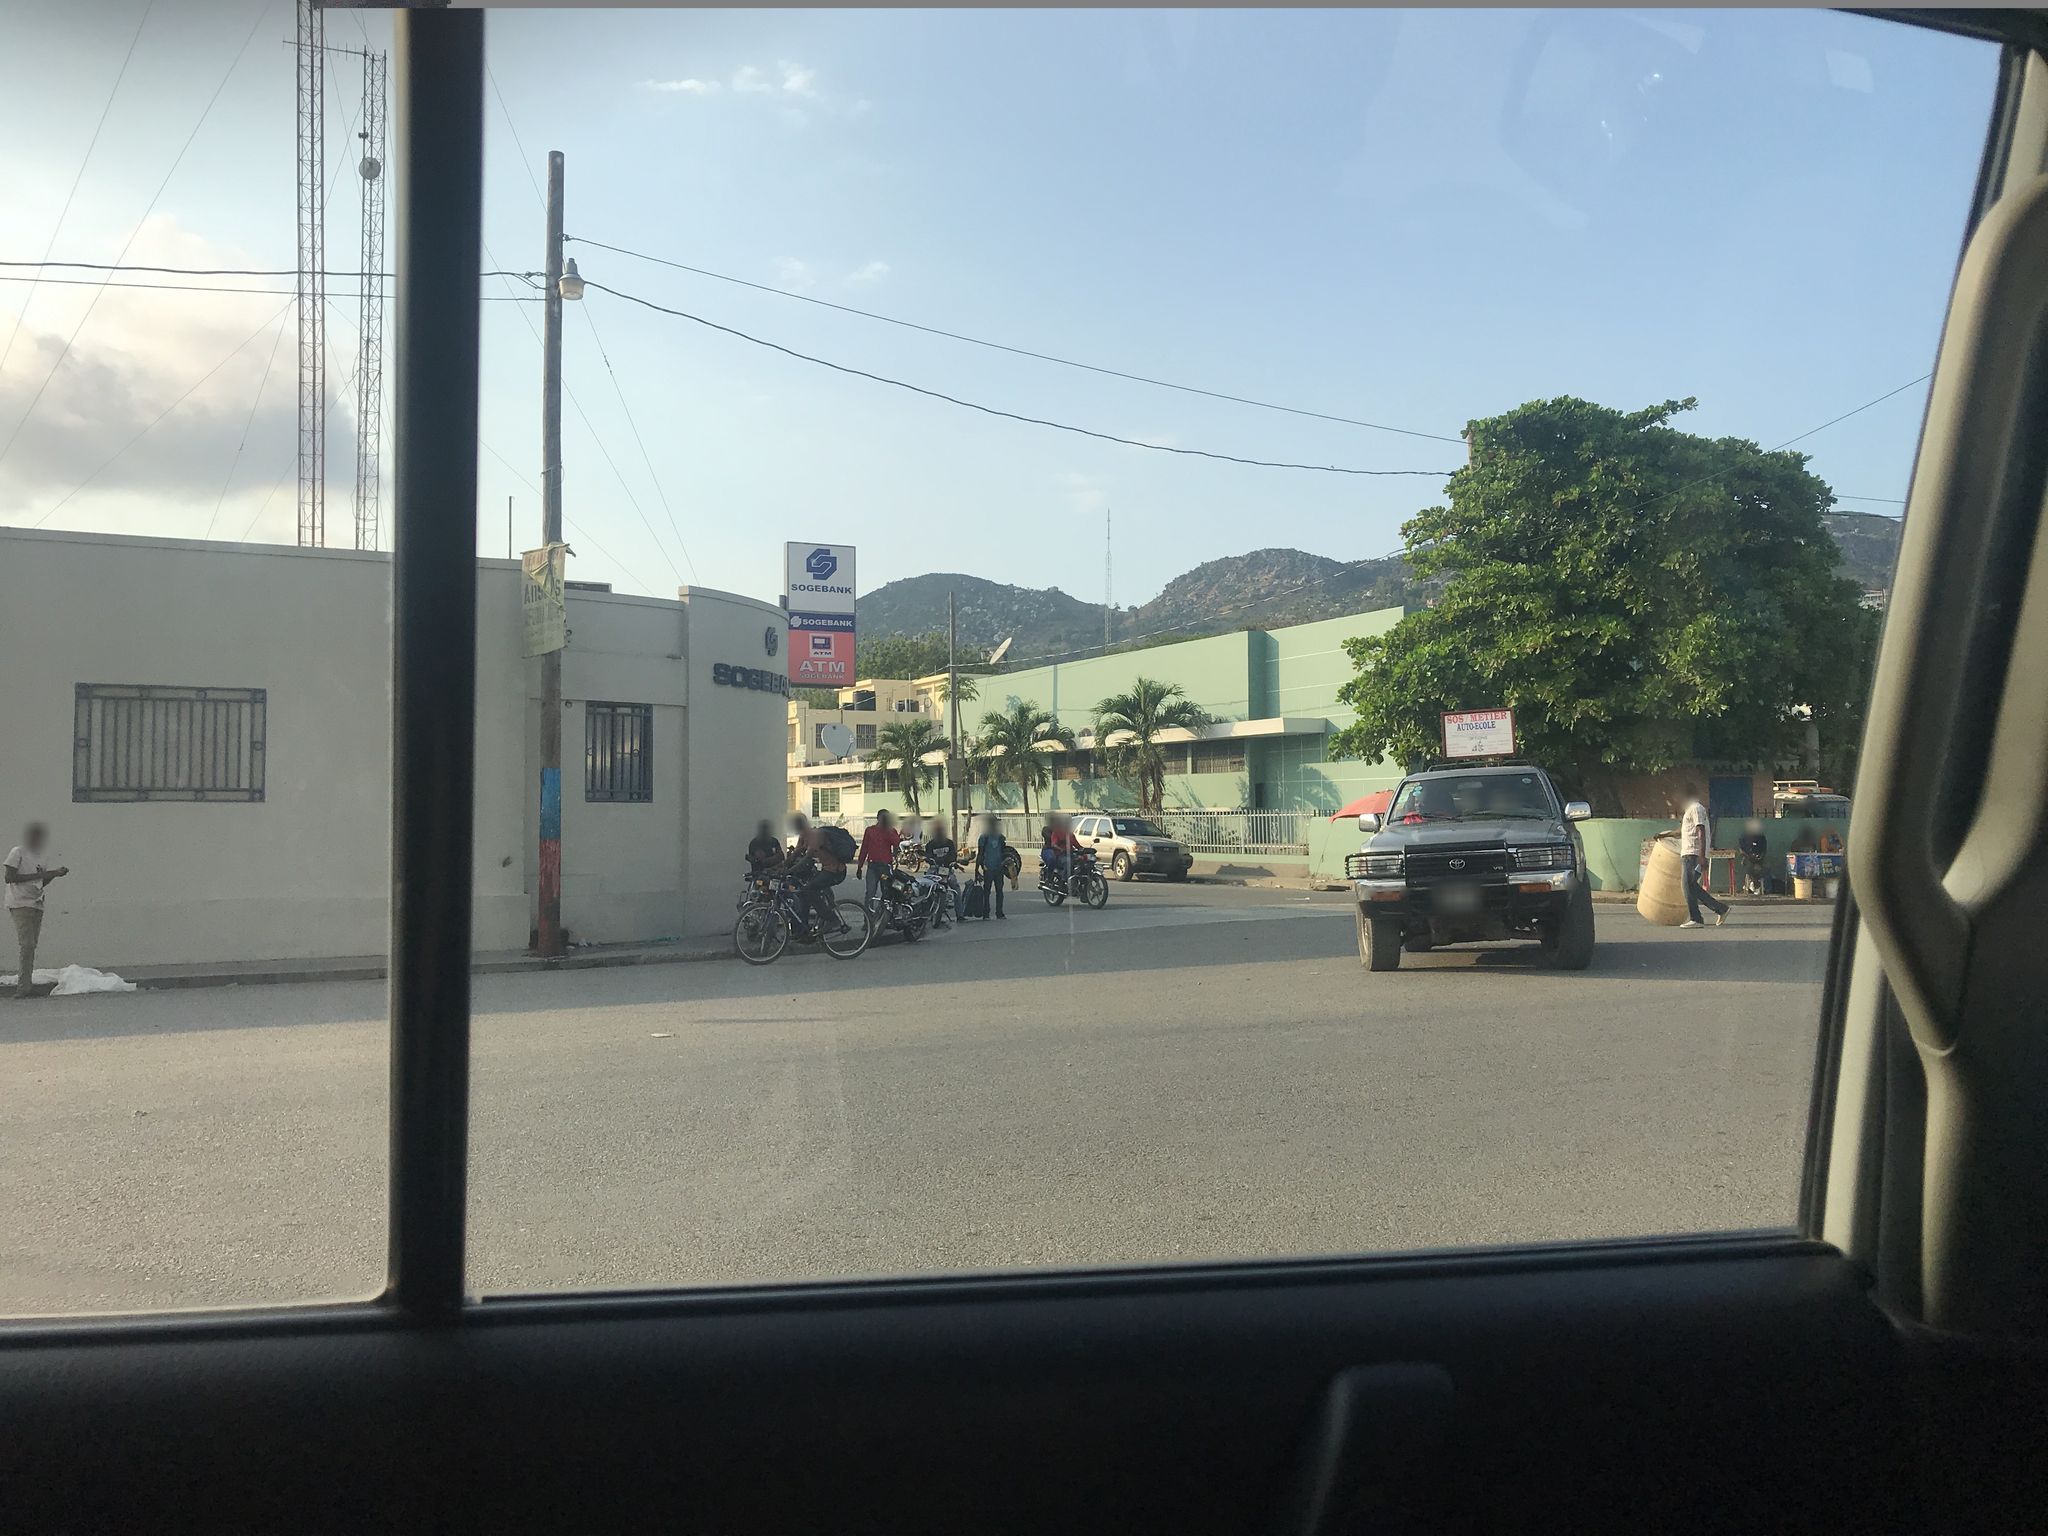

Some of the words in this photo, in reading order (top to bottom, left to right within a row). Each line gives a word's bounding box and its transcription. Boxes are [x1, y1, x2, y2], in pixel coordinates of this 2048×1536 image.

[791, 584, 852, 594] SOGEBANK
[802, 618, 853, 627] SOGEBANK
[799, 661, 845, 673] ATM
[1446, 715, 1464, 724] SOS
[1470, 711, 1507, 722] METIER
